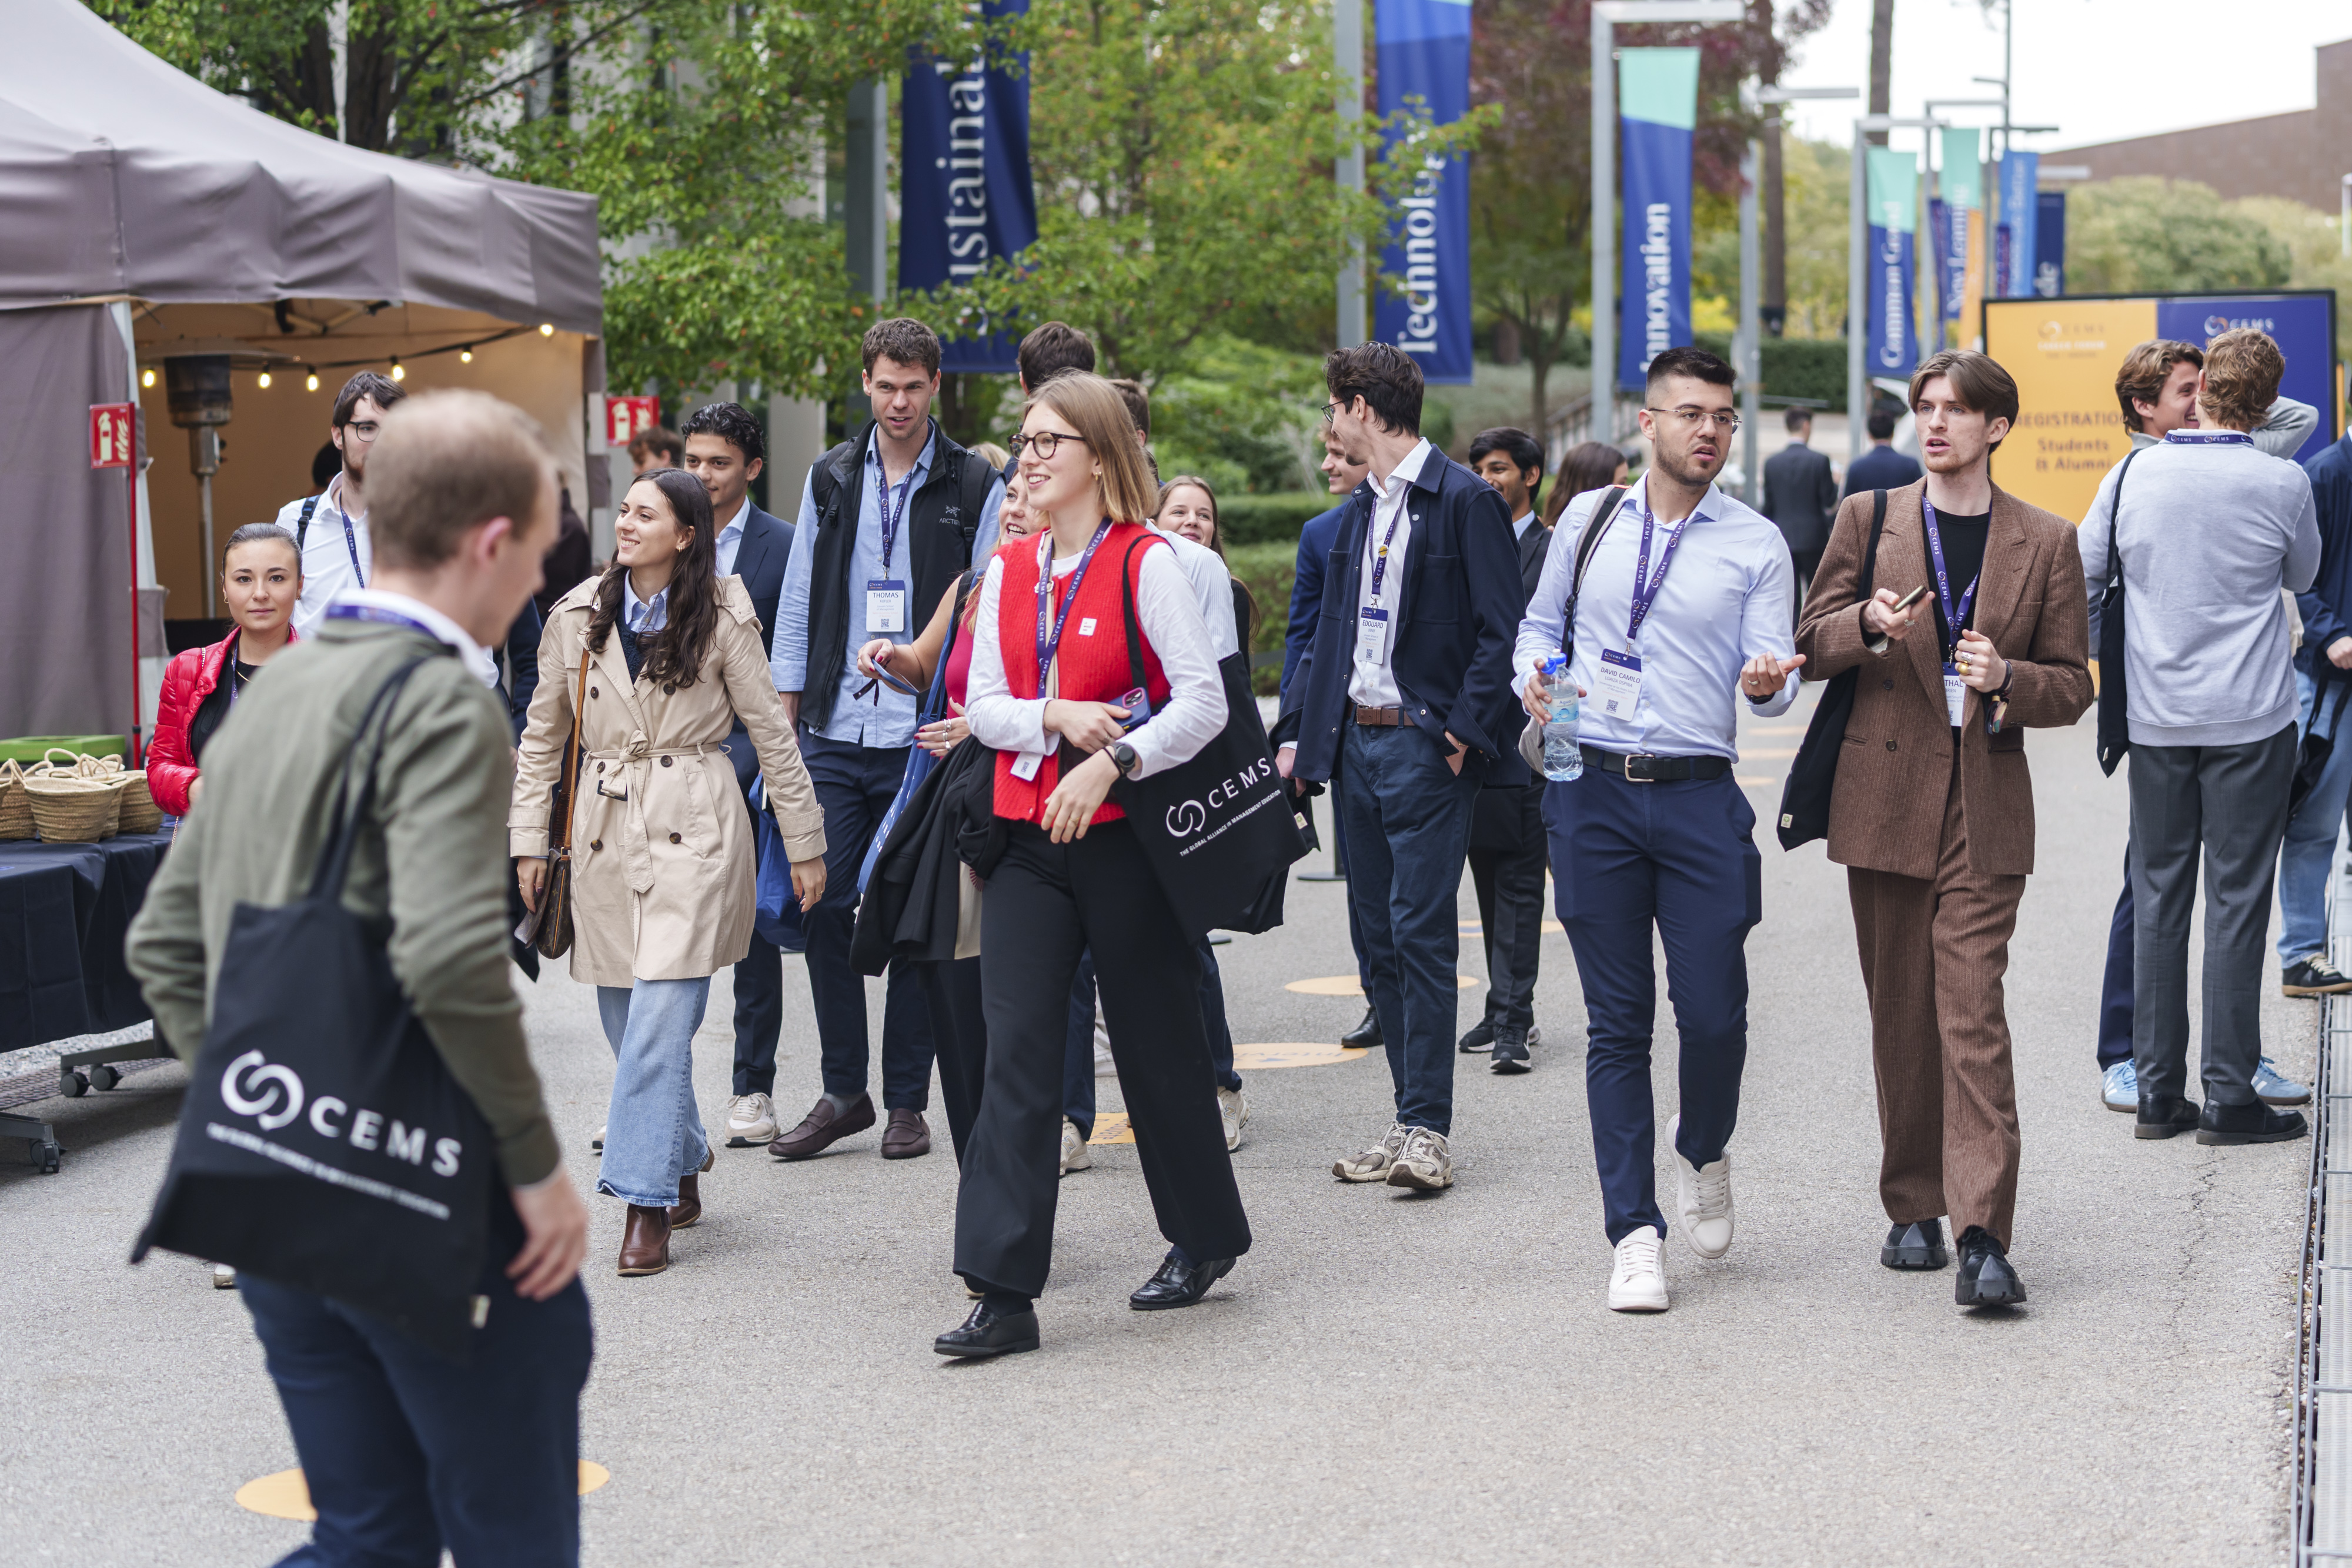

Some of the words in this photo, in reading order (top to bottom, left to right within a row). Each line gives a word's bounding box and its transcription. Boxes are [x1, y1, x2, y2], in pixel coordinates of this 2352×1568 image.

[2016, 412, 2123, 427] REGISTRATIO
[2037, 437, 2109, 452] Students
[2055, 456, 2112, 471] Alumni
[1674, 521, 1684, 538] CEMS
[1092, 530, 1104, 547] CEMS
[1656, 562, 1667, 579] CEMS
[1072, 571, 1083, 590] CEMS
[1638, 602, 1648, 619] CEMS
[1055, 615, 1064, 634] CEMS
[1362, 620, 1384, 628] EDOUARD
[1955, 612, 1964, 630] CEMS
[1600, 667, 1618, 676] DAVID
[1619, 673, 1641, 683] CAMILO
[1208, 758, 1271, 808] CEMS
[1180, 848, 1190, 857] THE
[1189, 838, 1207, 851] GLOBAL
[1207, 824, 1228, 841] ALLIANCE
[1231, 802, 1262, 824] MANAGEMENT
[1261, 789, 1281, 805] EDUCATION
[309, 1095, 462, 1176] CEMS
